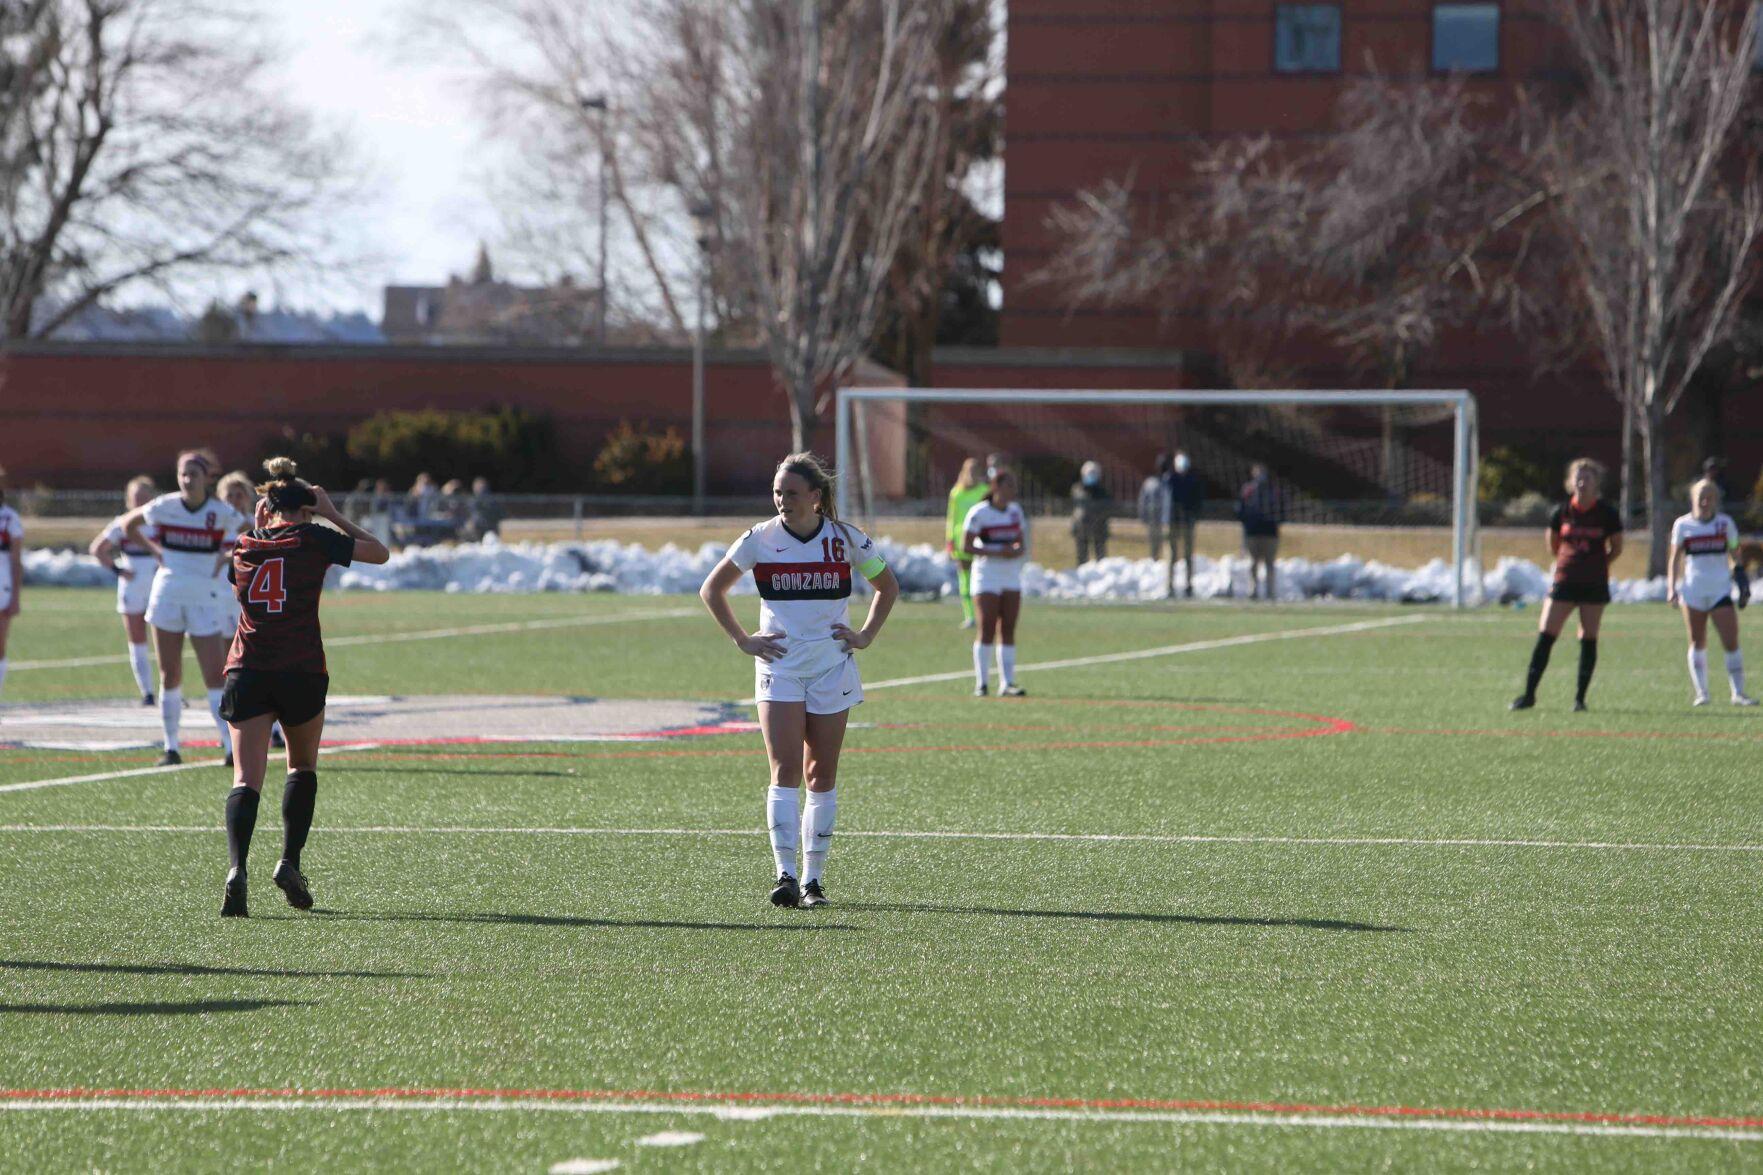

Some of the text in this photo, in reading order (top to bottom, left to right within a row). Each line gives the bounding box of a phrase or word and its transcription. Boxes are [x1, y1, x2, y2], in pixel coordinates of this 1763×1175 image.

[822, 537, 845, 562] 16
[248, 557, 286, 613] 4
[771, 572, 840, 590] GONZAGA
